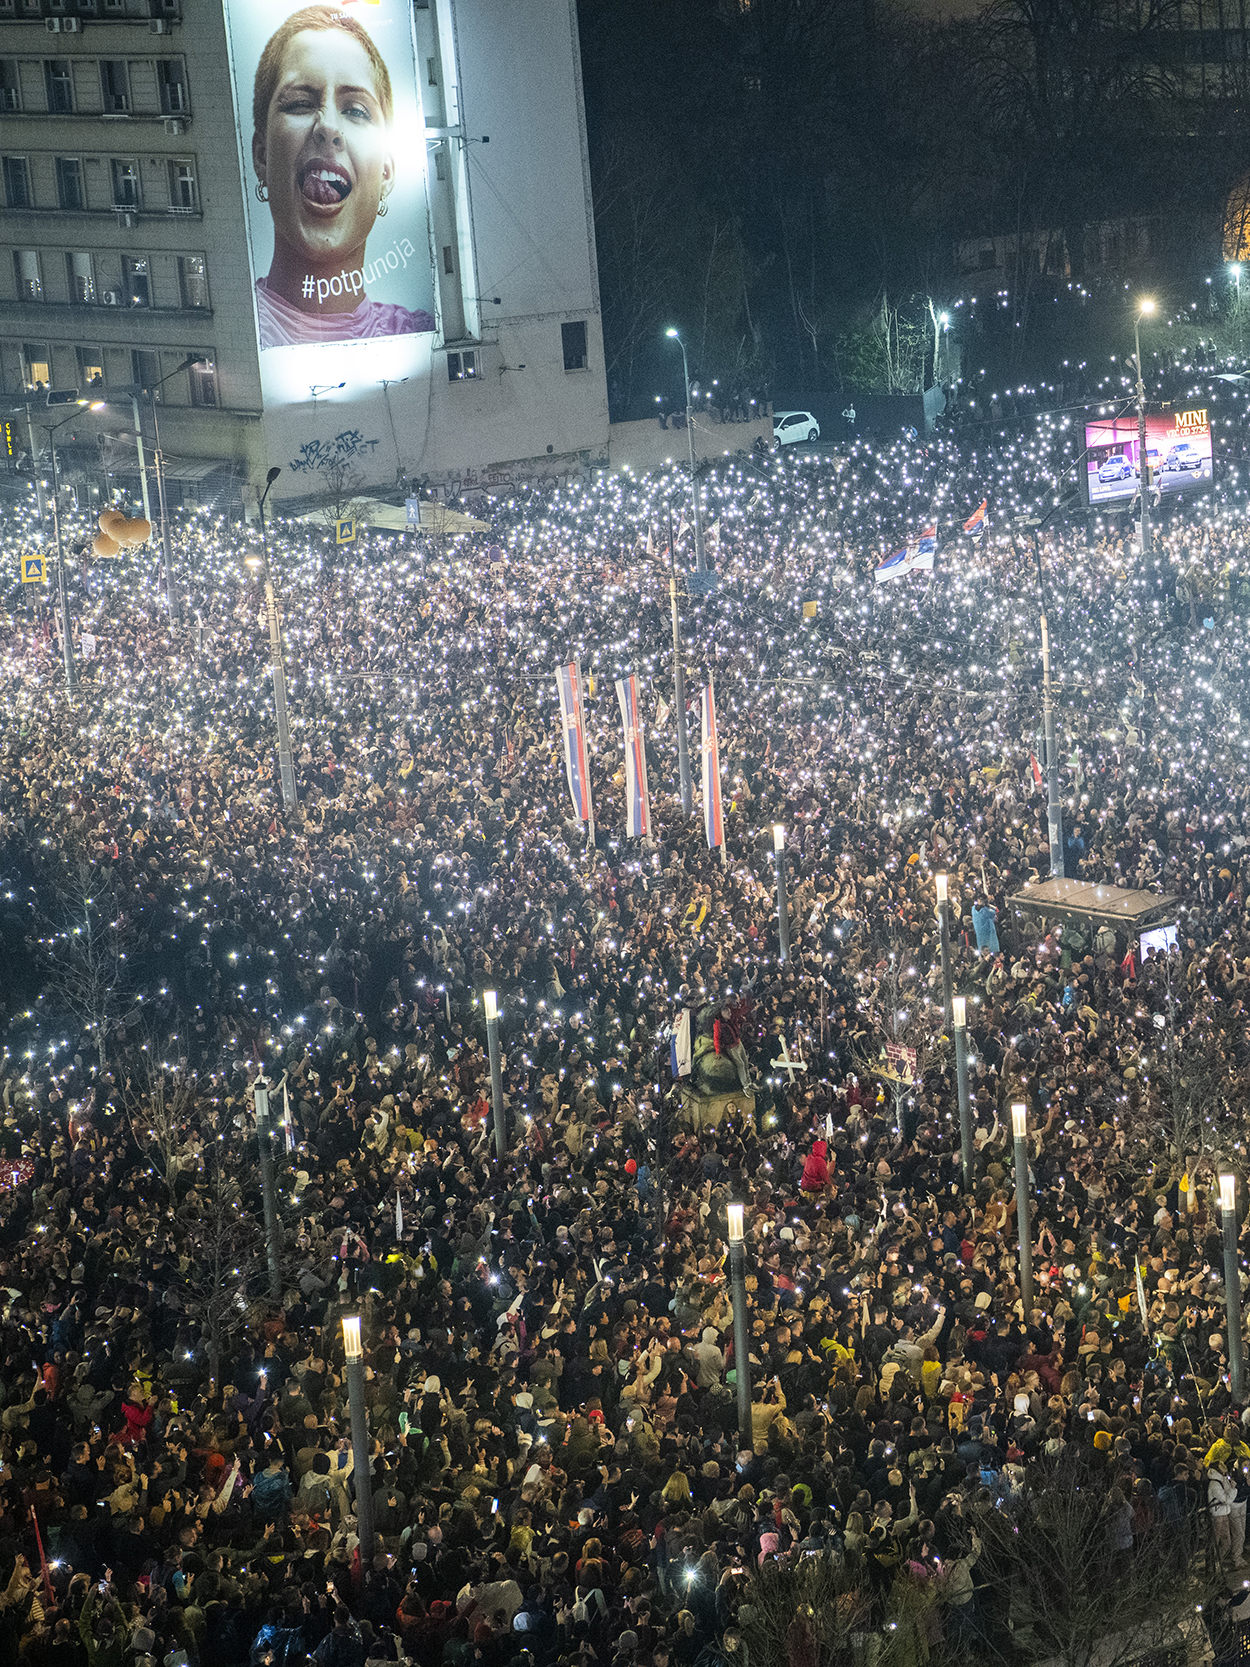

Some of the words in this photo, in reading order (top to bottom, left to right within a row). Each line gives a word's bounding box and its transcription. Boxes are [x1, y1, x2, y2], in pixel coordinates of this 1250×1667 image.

[302, 238, 415, 304] #potpunoja
[1174, 409, 1208, 428] MINI
[1180, 427, 1190, 436] OD
